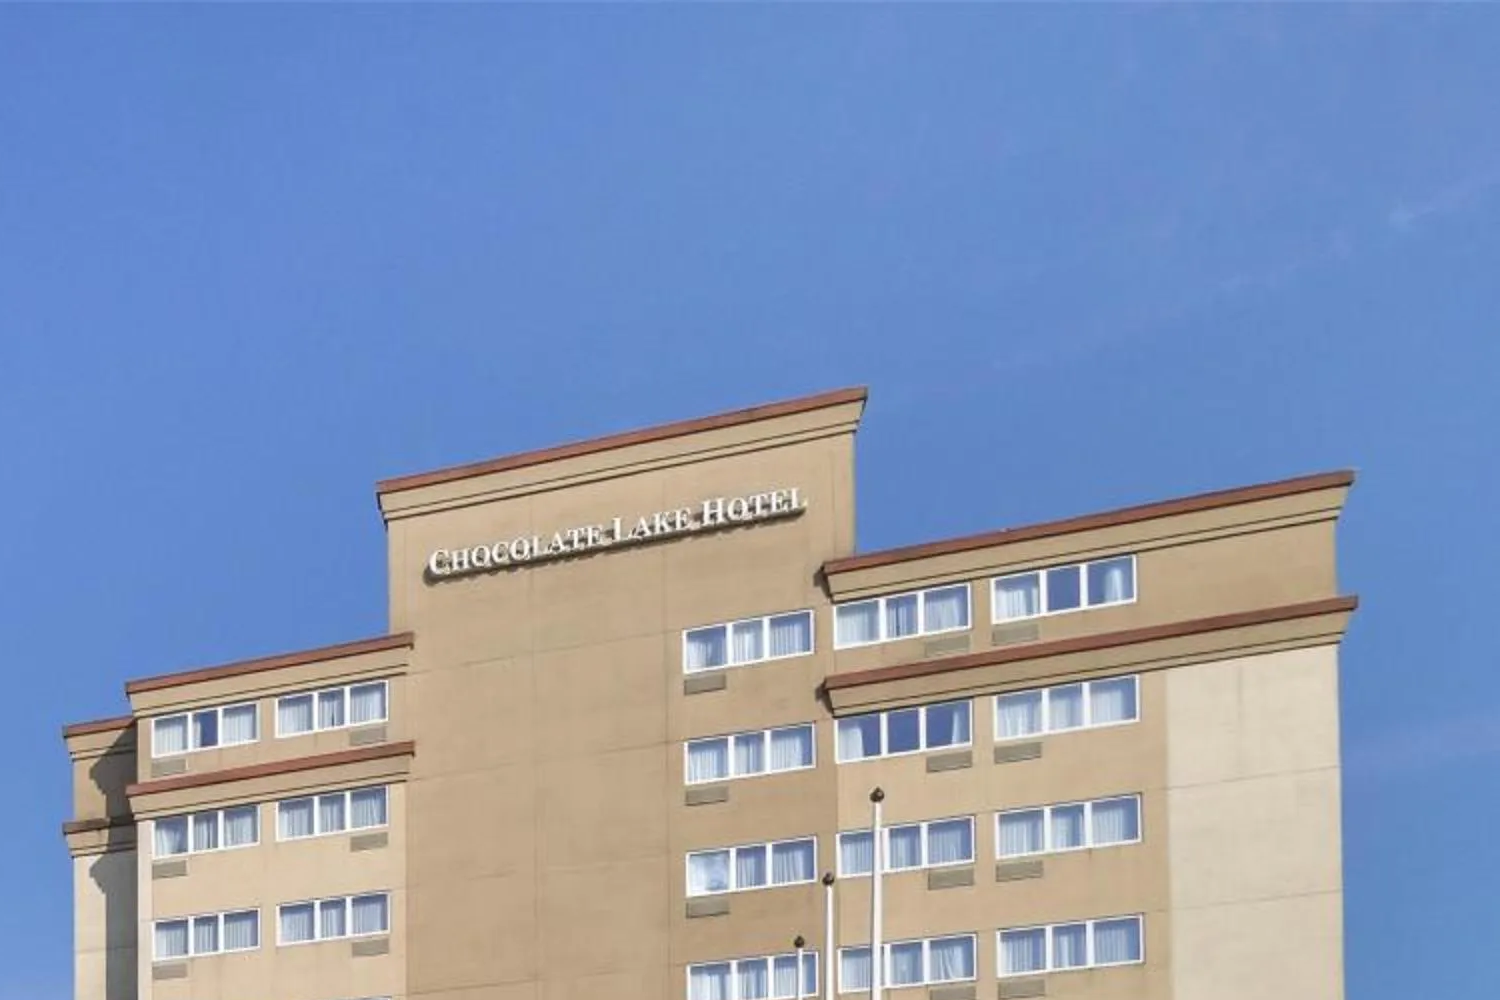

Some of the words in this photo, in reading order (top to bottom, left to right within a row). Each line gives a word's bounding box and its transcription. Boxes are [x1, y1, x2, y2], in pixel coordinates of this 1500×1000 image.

[428, 521, 605, 575] CHOCOLATE
[610, 505, 698, 543] LAKE
[700, 487, 808, 527] HOTEL
